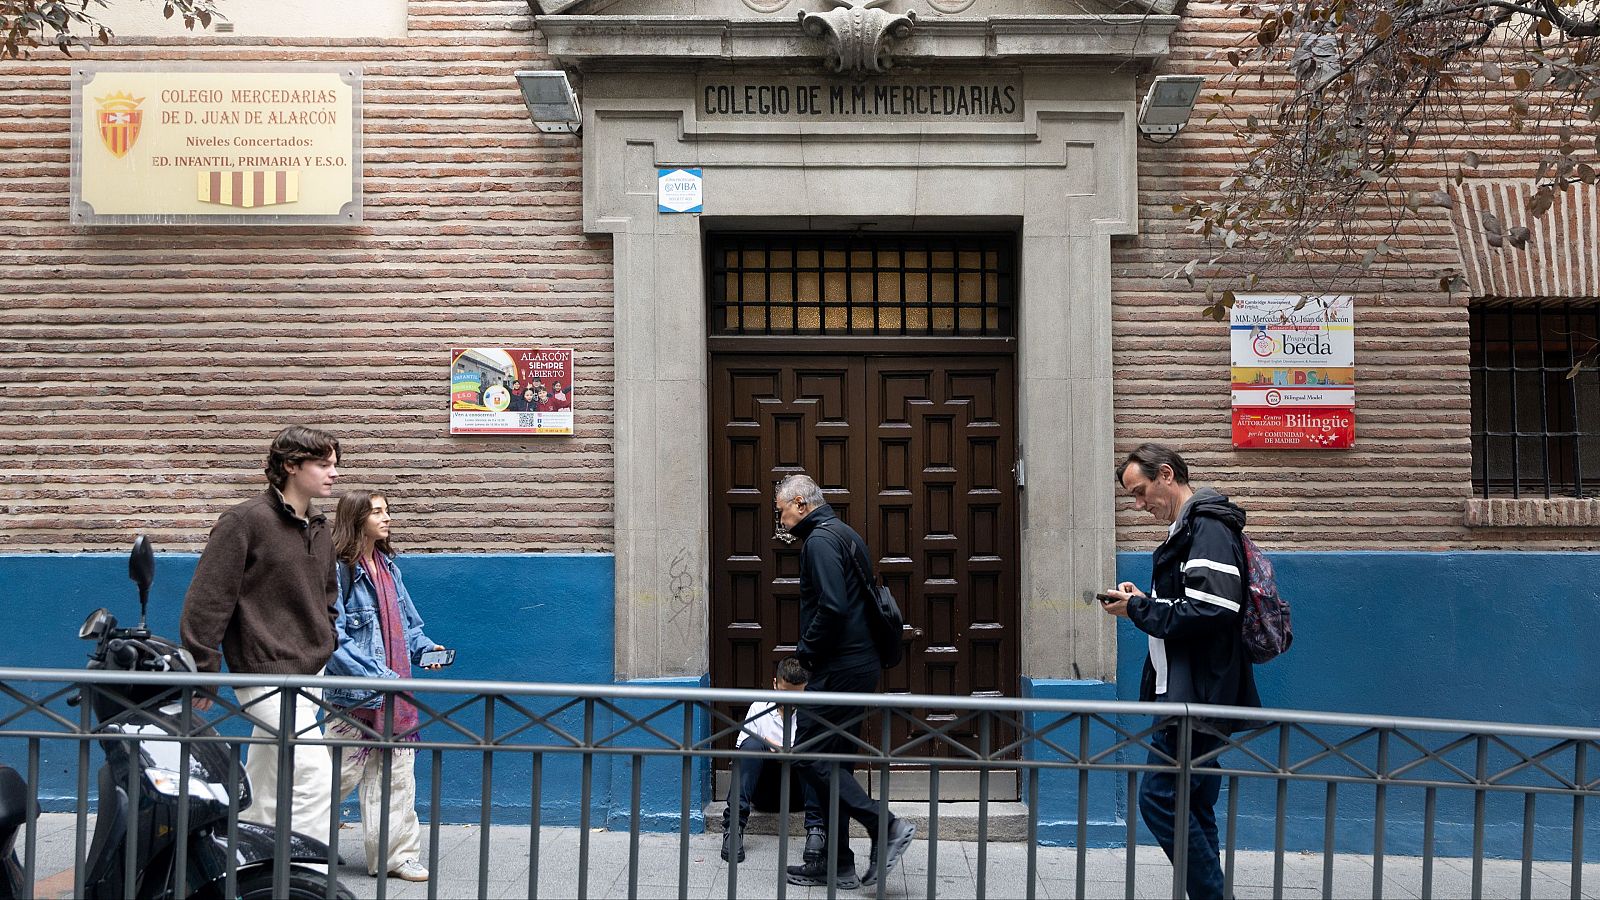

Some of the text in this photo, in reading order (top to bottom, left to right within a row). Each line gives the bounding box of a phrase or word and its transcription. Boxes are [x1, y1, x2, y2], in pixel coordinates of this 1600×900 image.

[161, 89, 337, 104] COLEGIO MERCEDARIAS
[704, 85, 790, 115] COLEGIO
[796, 85, 822, 115] DE
[161, 107, 337, 125] DE D. JUAN DE ALARCÓN
[185, 136, 313, 147] Niveles Concertados:
[152, 156, 347, 168] ED. INFANTIL, PRIMARIA Y E.S.O.
[674, 182, 697, 191] VIBA
[1300, 315, 1315, 323] Juan
[1315, 315, 1324, 323] de
[1325, 314, 1349, 322] Alcón
[1281, 334, 1333, 355] beda
[521, 350, 568, 361] ALARCÓN
[528, 361, 564, 370] SIEMPRE
[528, 370, 565, 378] ABIERTO
[1285, 413, 1349, 432] Bilingüe
